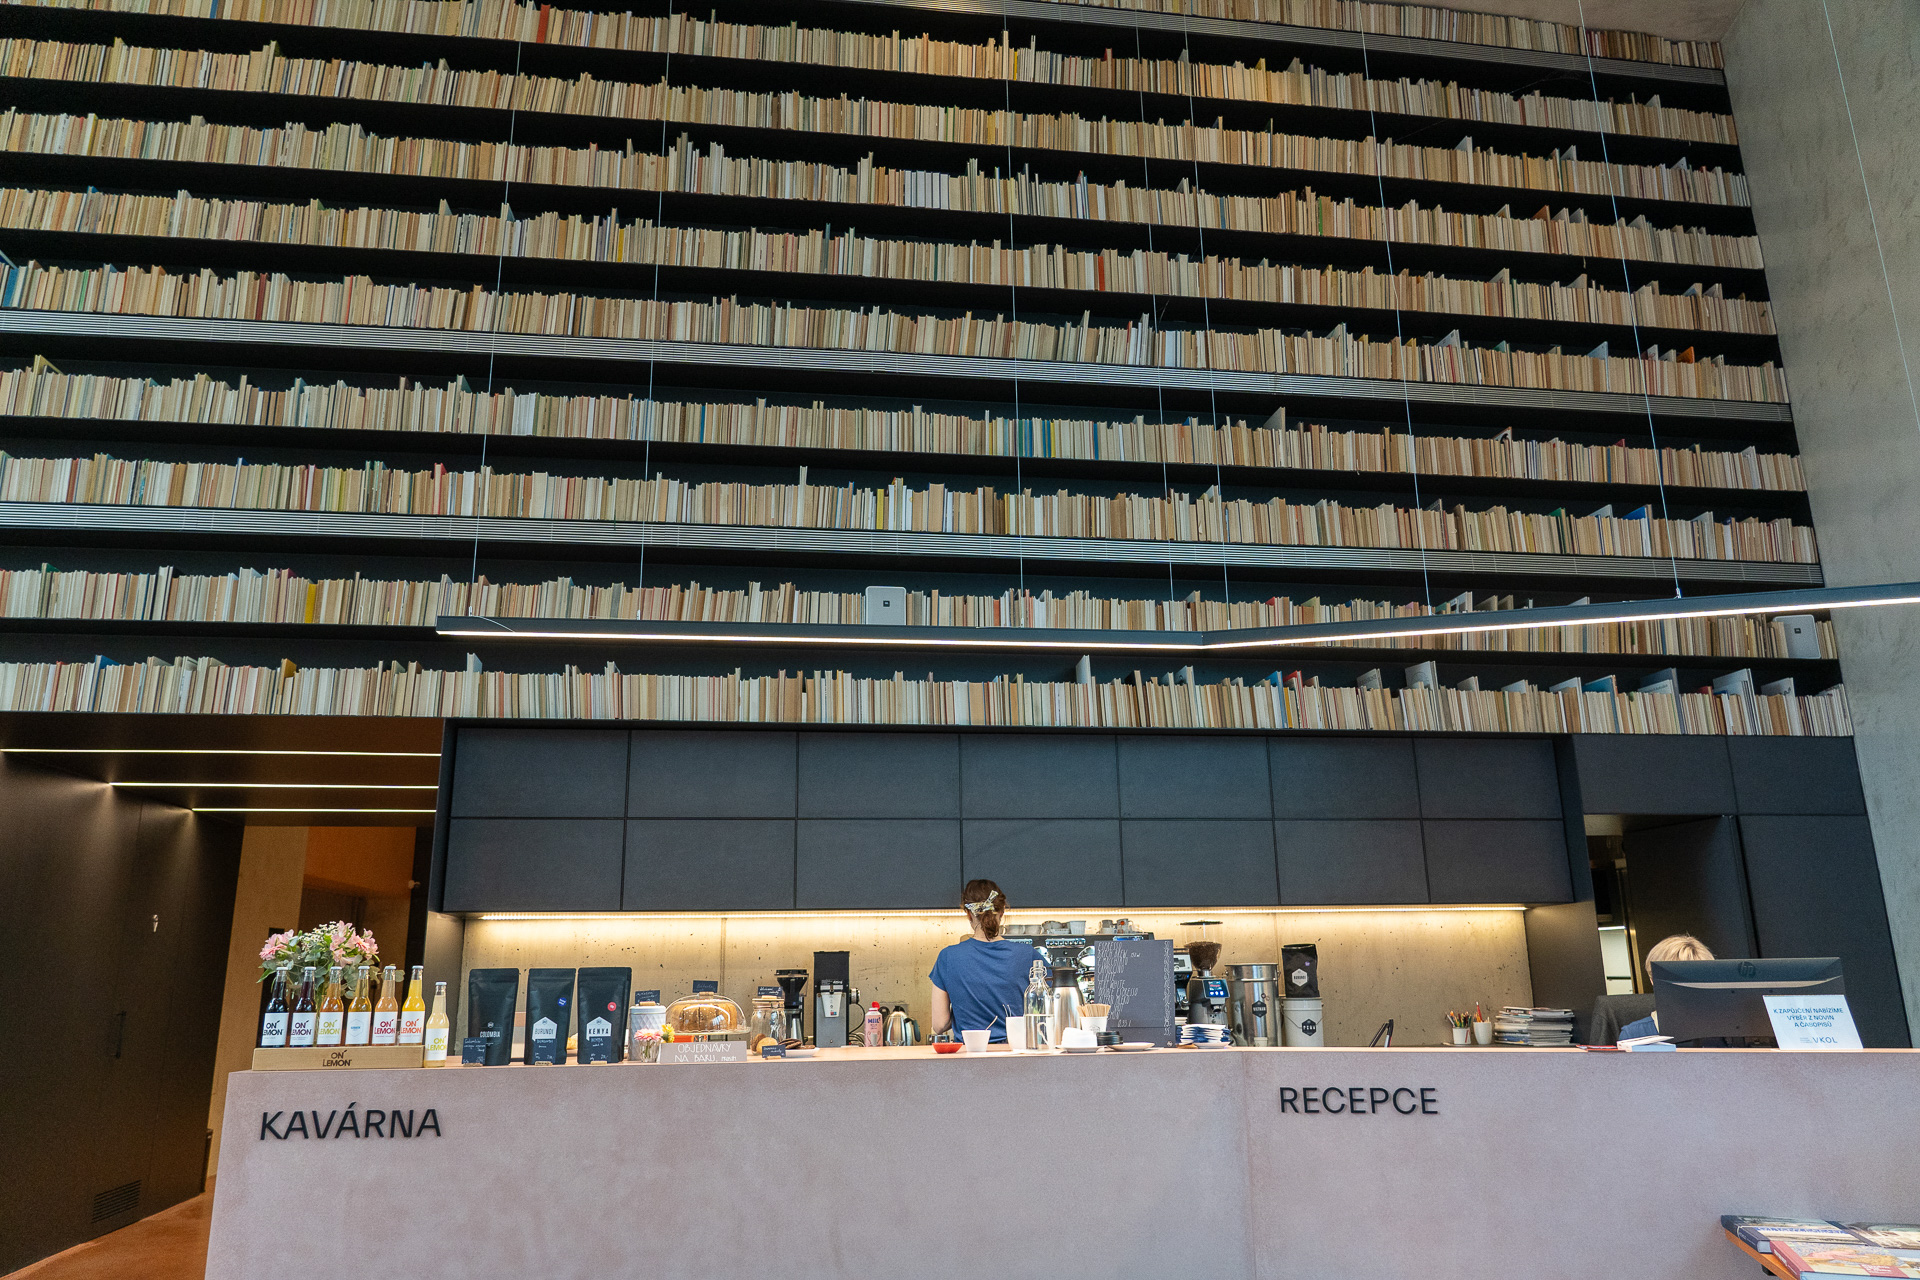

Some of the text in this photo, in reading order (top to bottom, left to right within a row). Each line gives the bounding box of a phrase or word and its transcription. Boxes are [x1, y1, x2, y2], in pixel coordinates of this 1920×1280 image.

[323, 1059, 351, 1067] LEMON
[675, 1054, 689, 1062] NA
[1280, 1087, 1438, 1115] RECEPCE
[260, 1101, 441, 1140] KAVÁRNA
